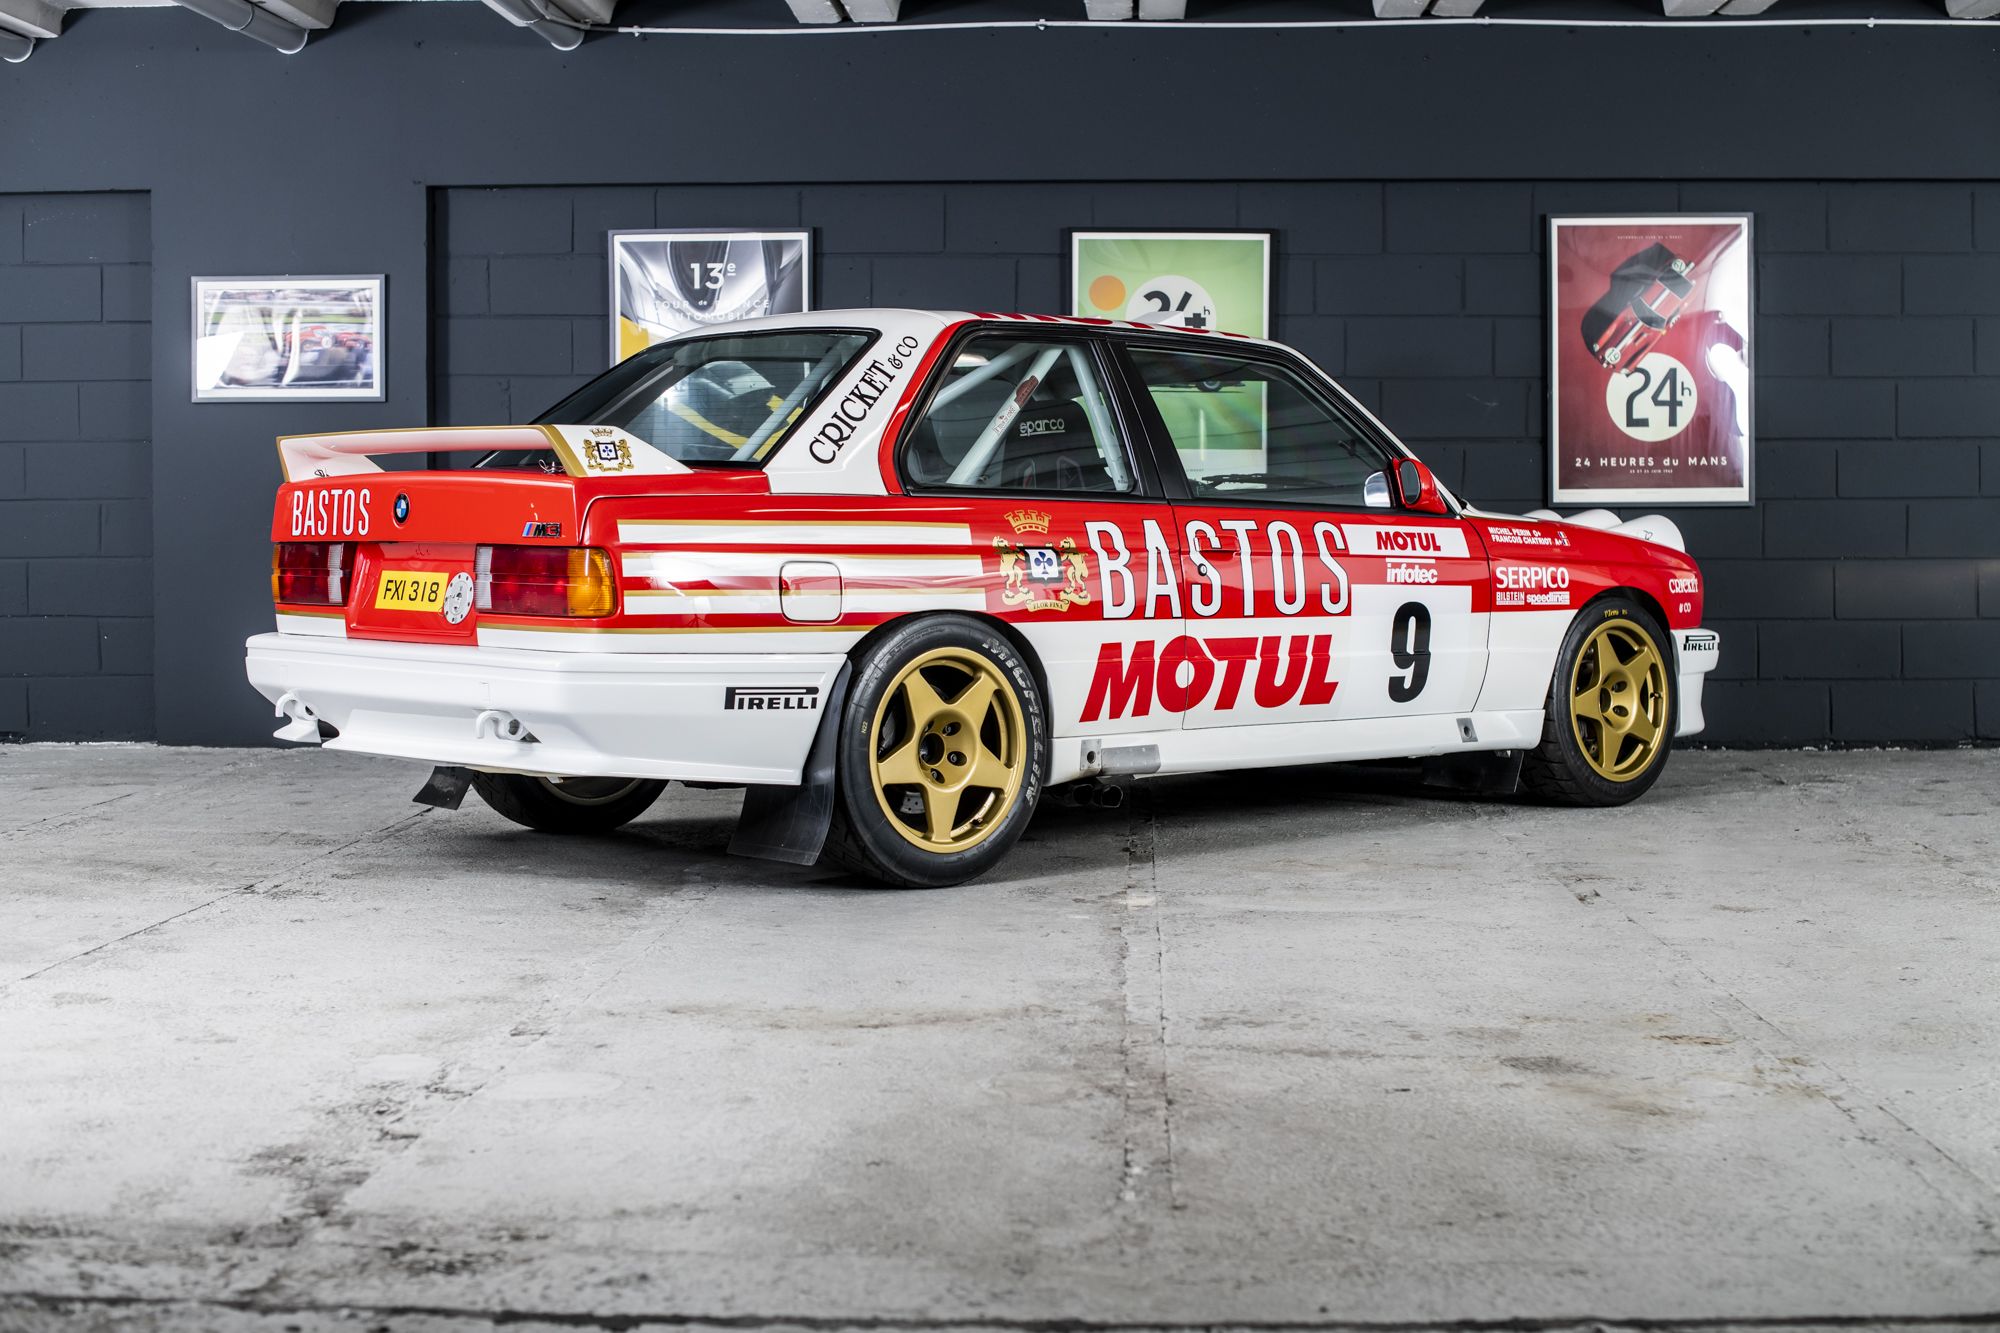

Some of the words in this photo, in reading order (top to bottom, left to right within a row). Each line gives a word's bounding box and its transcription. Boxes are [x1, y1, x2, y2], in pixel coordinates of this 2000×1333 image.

[656, 301, 689, 309] TOUR
[809, 359, 896, 464] CRICKET
[888, 354, 903, 369] &
[896, 336, 918, 358] CO
[1019, 418, 1066, 437] sparco
[1575, 457, 1591, 467] 24
[1600, 456, 1654, 467] HEURES
[1663, 456, 1679, 466] du
[1688, 456, 1728, 466] MANS
[291, 488, 371, 536] BASTOS
[532, 522, 562, 538] M3
[1487, 526, 1512, 536] MICHEL
[1512, 528, 1532, 537] PERIN
[1375, 531, 1442, 552] MOTUL
[1491, 534, 1522, 544] FRANCOIS
[1522, 536, 1552, 546] CHATRIOT
[1084, 518, 1350, 619] BASTOS
[1386, 562, 1438, 584] infotec
[1495, 566, 1570, 589] SERPICO
[383, 579, 407, 601] FXI
[408, 580, 440, 603] 318
[1668, 578, 1699, 593] CRICKET
[1496, 591, 1525, 601] BILSTEIN
[1526, 591, 1569, 605] speedline
[1683, 602, 1692, 613] CO
[1388, 601, 1431, 703] 9
[1683, 635, 1717, 651] PIRELLI
[1079, 634, 1339, 722] MOTUL
[724, 686, 820, 710] PIRELLI
